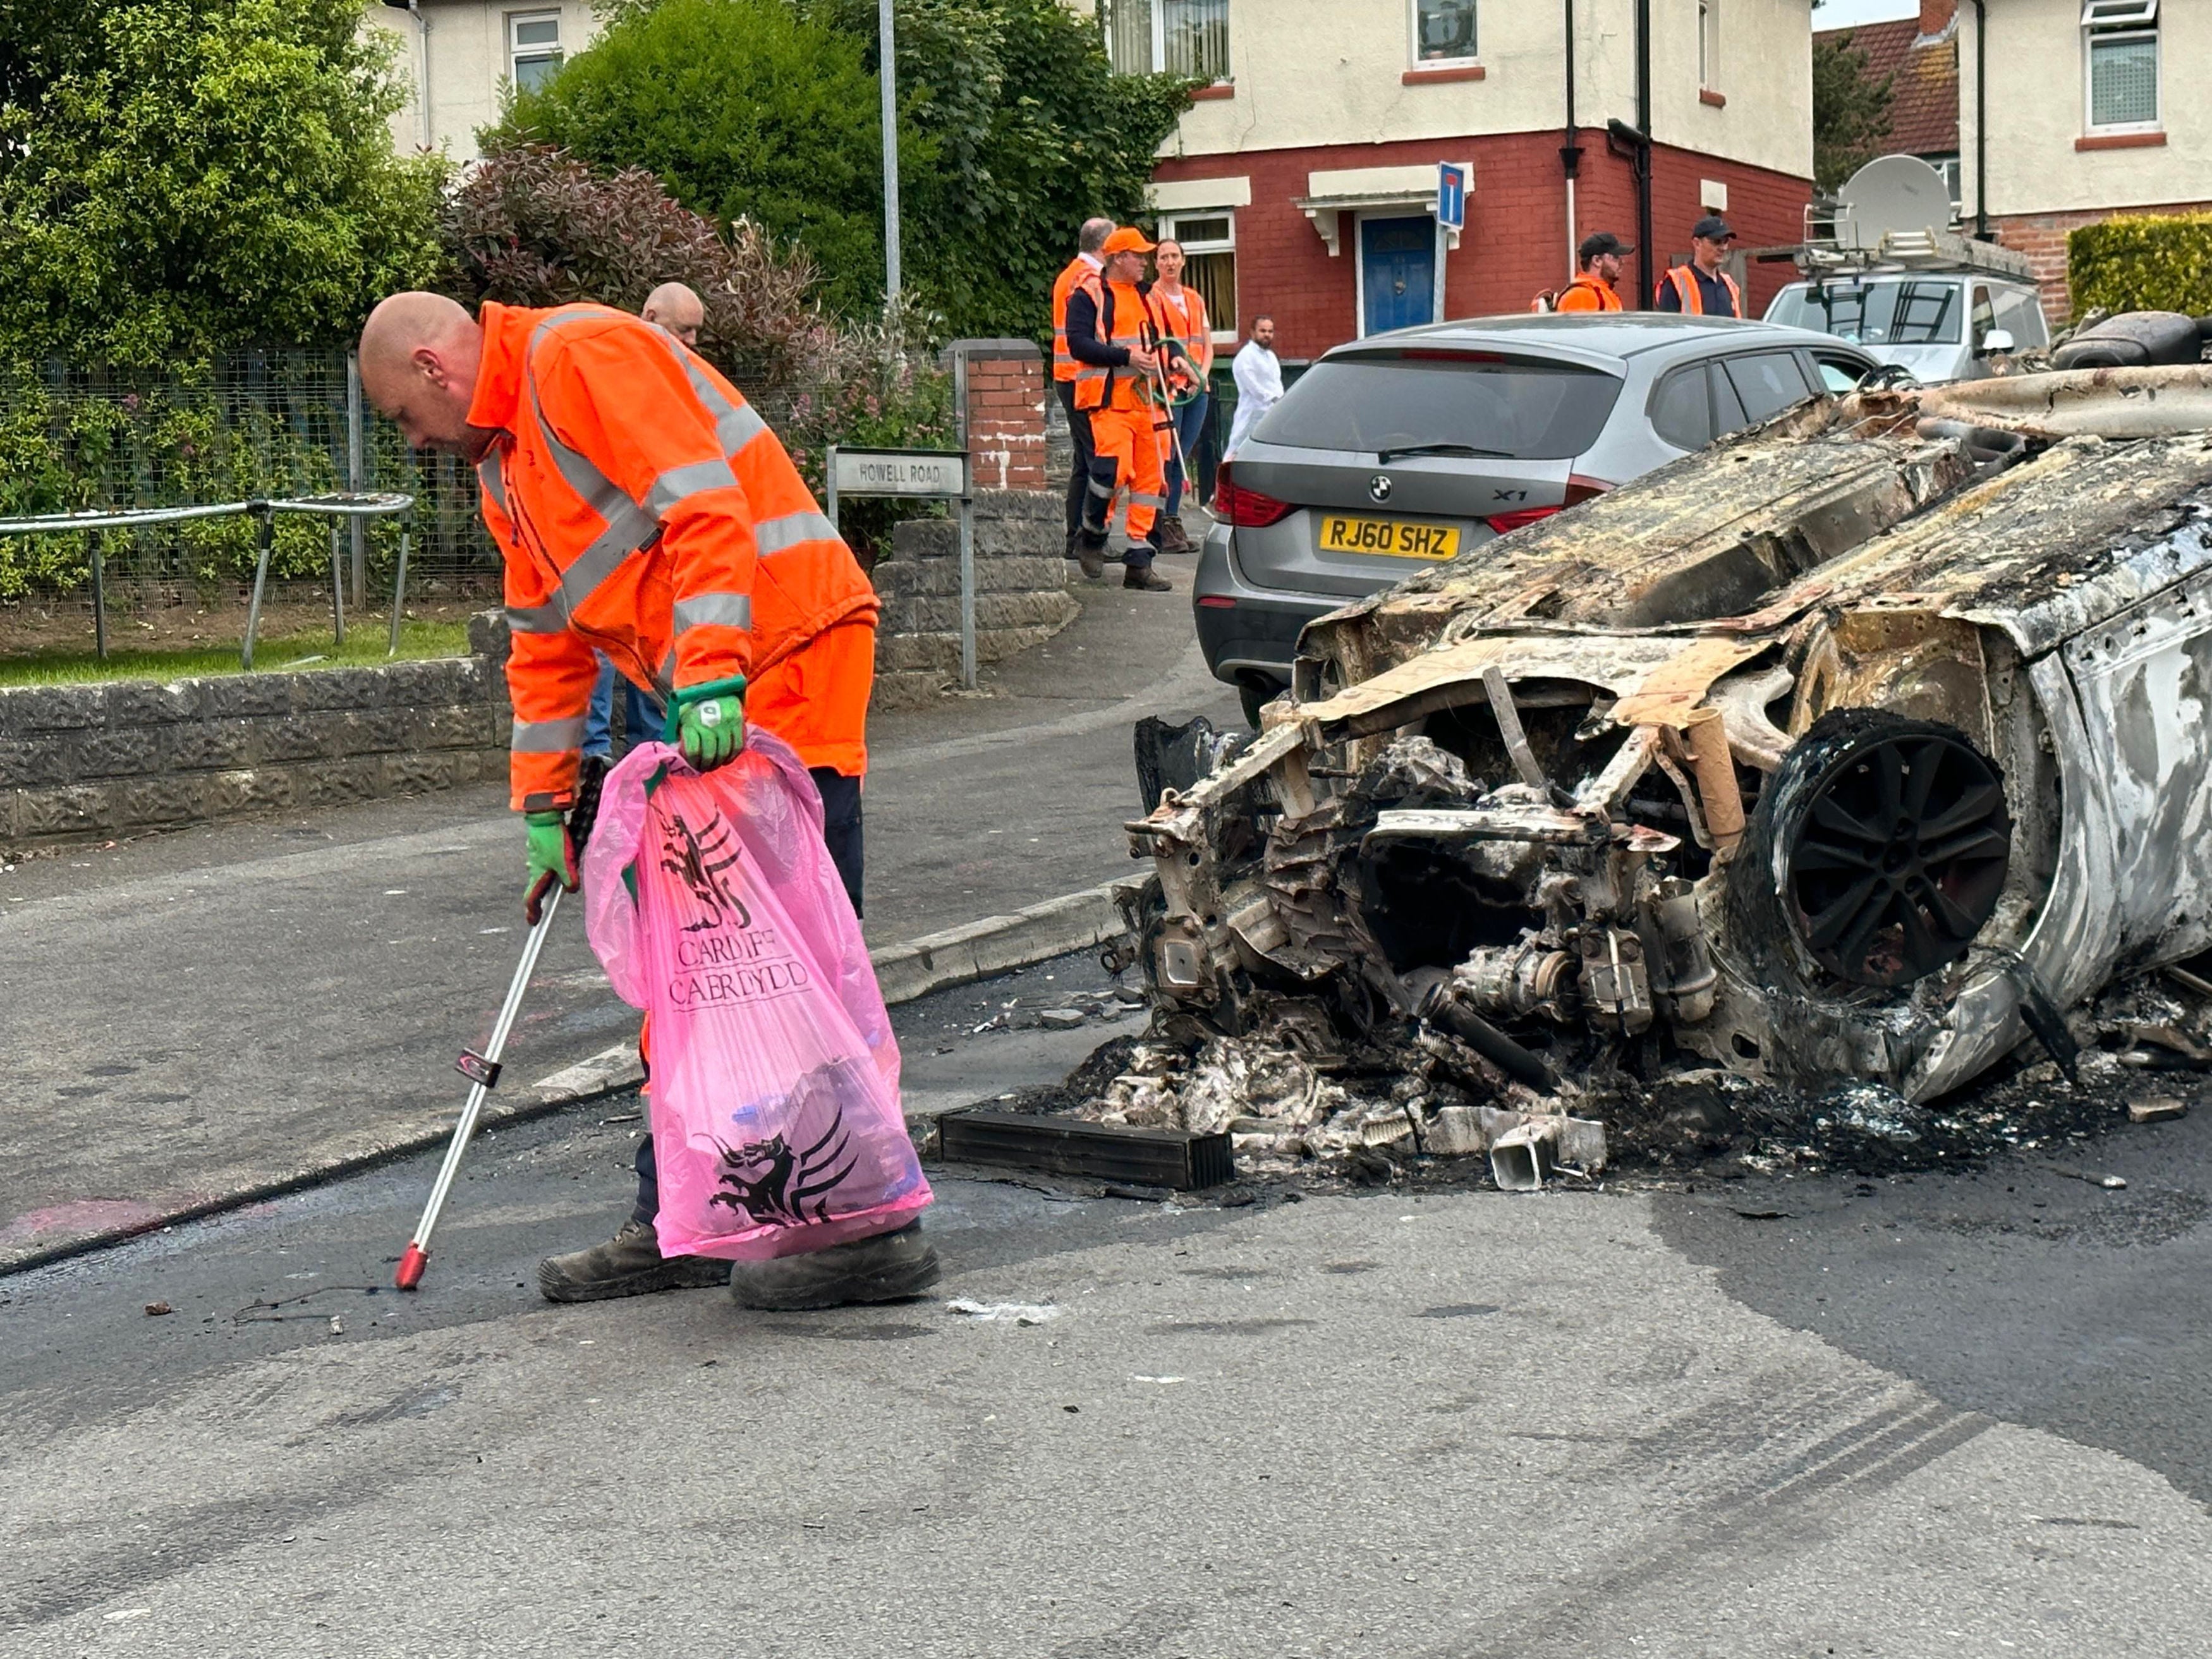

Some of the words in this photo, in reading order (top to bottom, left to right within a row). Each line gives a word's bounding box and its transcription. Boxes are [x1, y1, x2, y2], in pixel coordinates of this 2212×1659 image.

[860, 463, 906, 482] HOWELL
[910, 465, 940, 483] ROAD
[1492, 489, 1528, 501] X1
[1329, 520, 1394, 549] RJ60
[1399, 526, 1448, 556] SHZ
[678, 929, 775, 966] CARDIFF
[669, 961, 808, 1005] CAERDYDD
